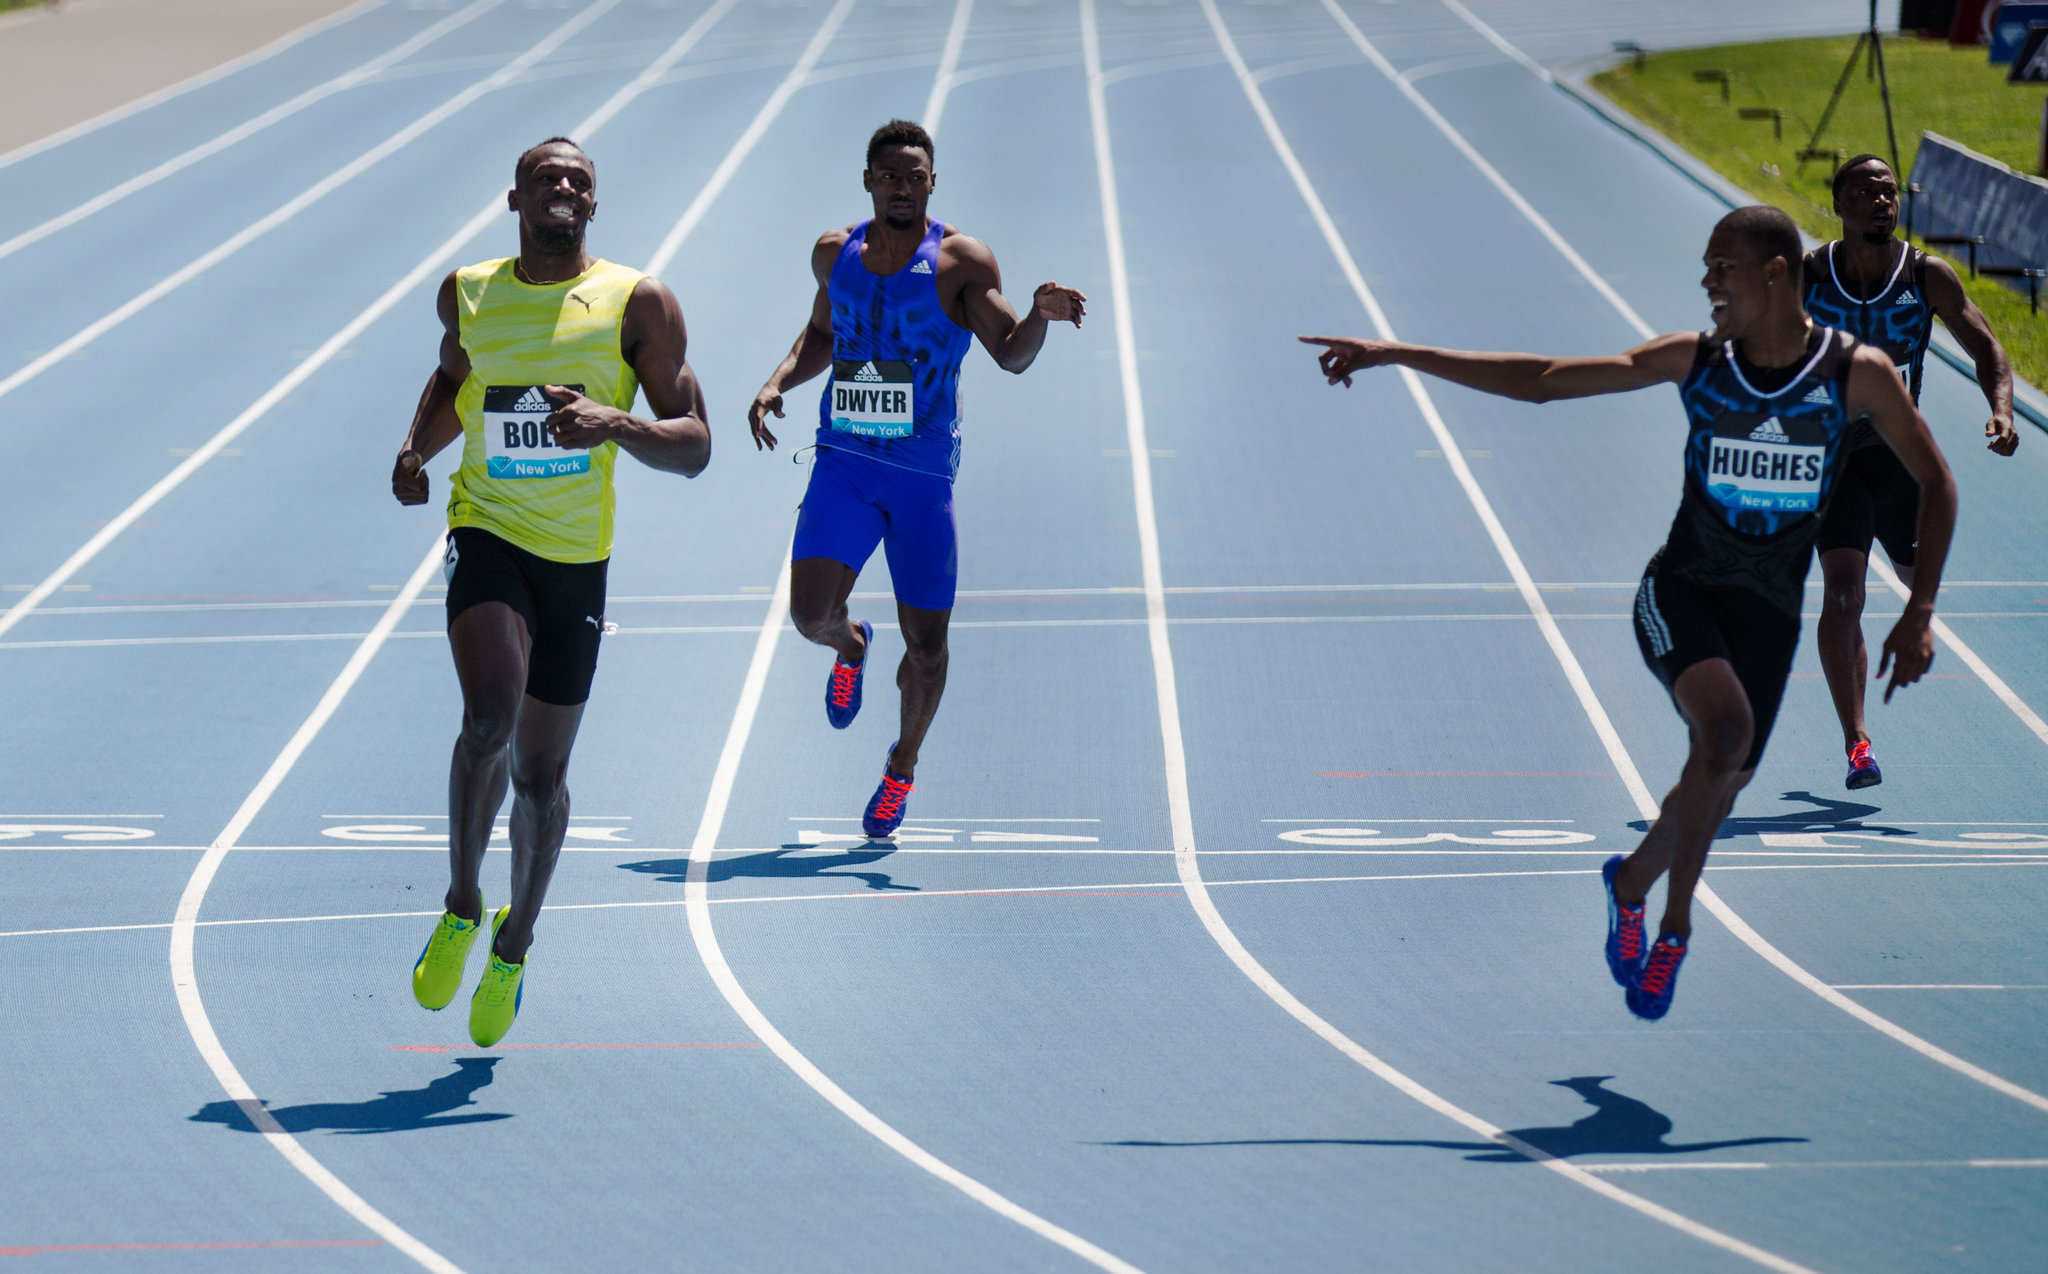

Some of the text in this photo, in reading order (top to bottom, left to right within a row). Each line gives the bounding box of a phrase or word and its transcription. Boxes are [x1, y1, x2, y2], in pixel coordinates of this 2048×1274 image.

[854, 374, 884, 382] adidas
[514, 401, 551, 412] adidas
[836, 388, 906, 413] DWYER
[503, 421, 563, 449] BOL
[852, 424, 905, 436] New York
[1749, 431, 1790, 443] adidas
[515, 460, 581, 475] New York
[1712, 446, 1821, 482] HUGHES
[1741, 494, 1809, 508] New York
[1277, 827, 1596, 846] 3
